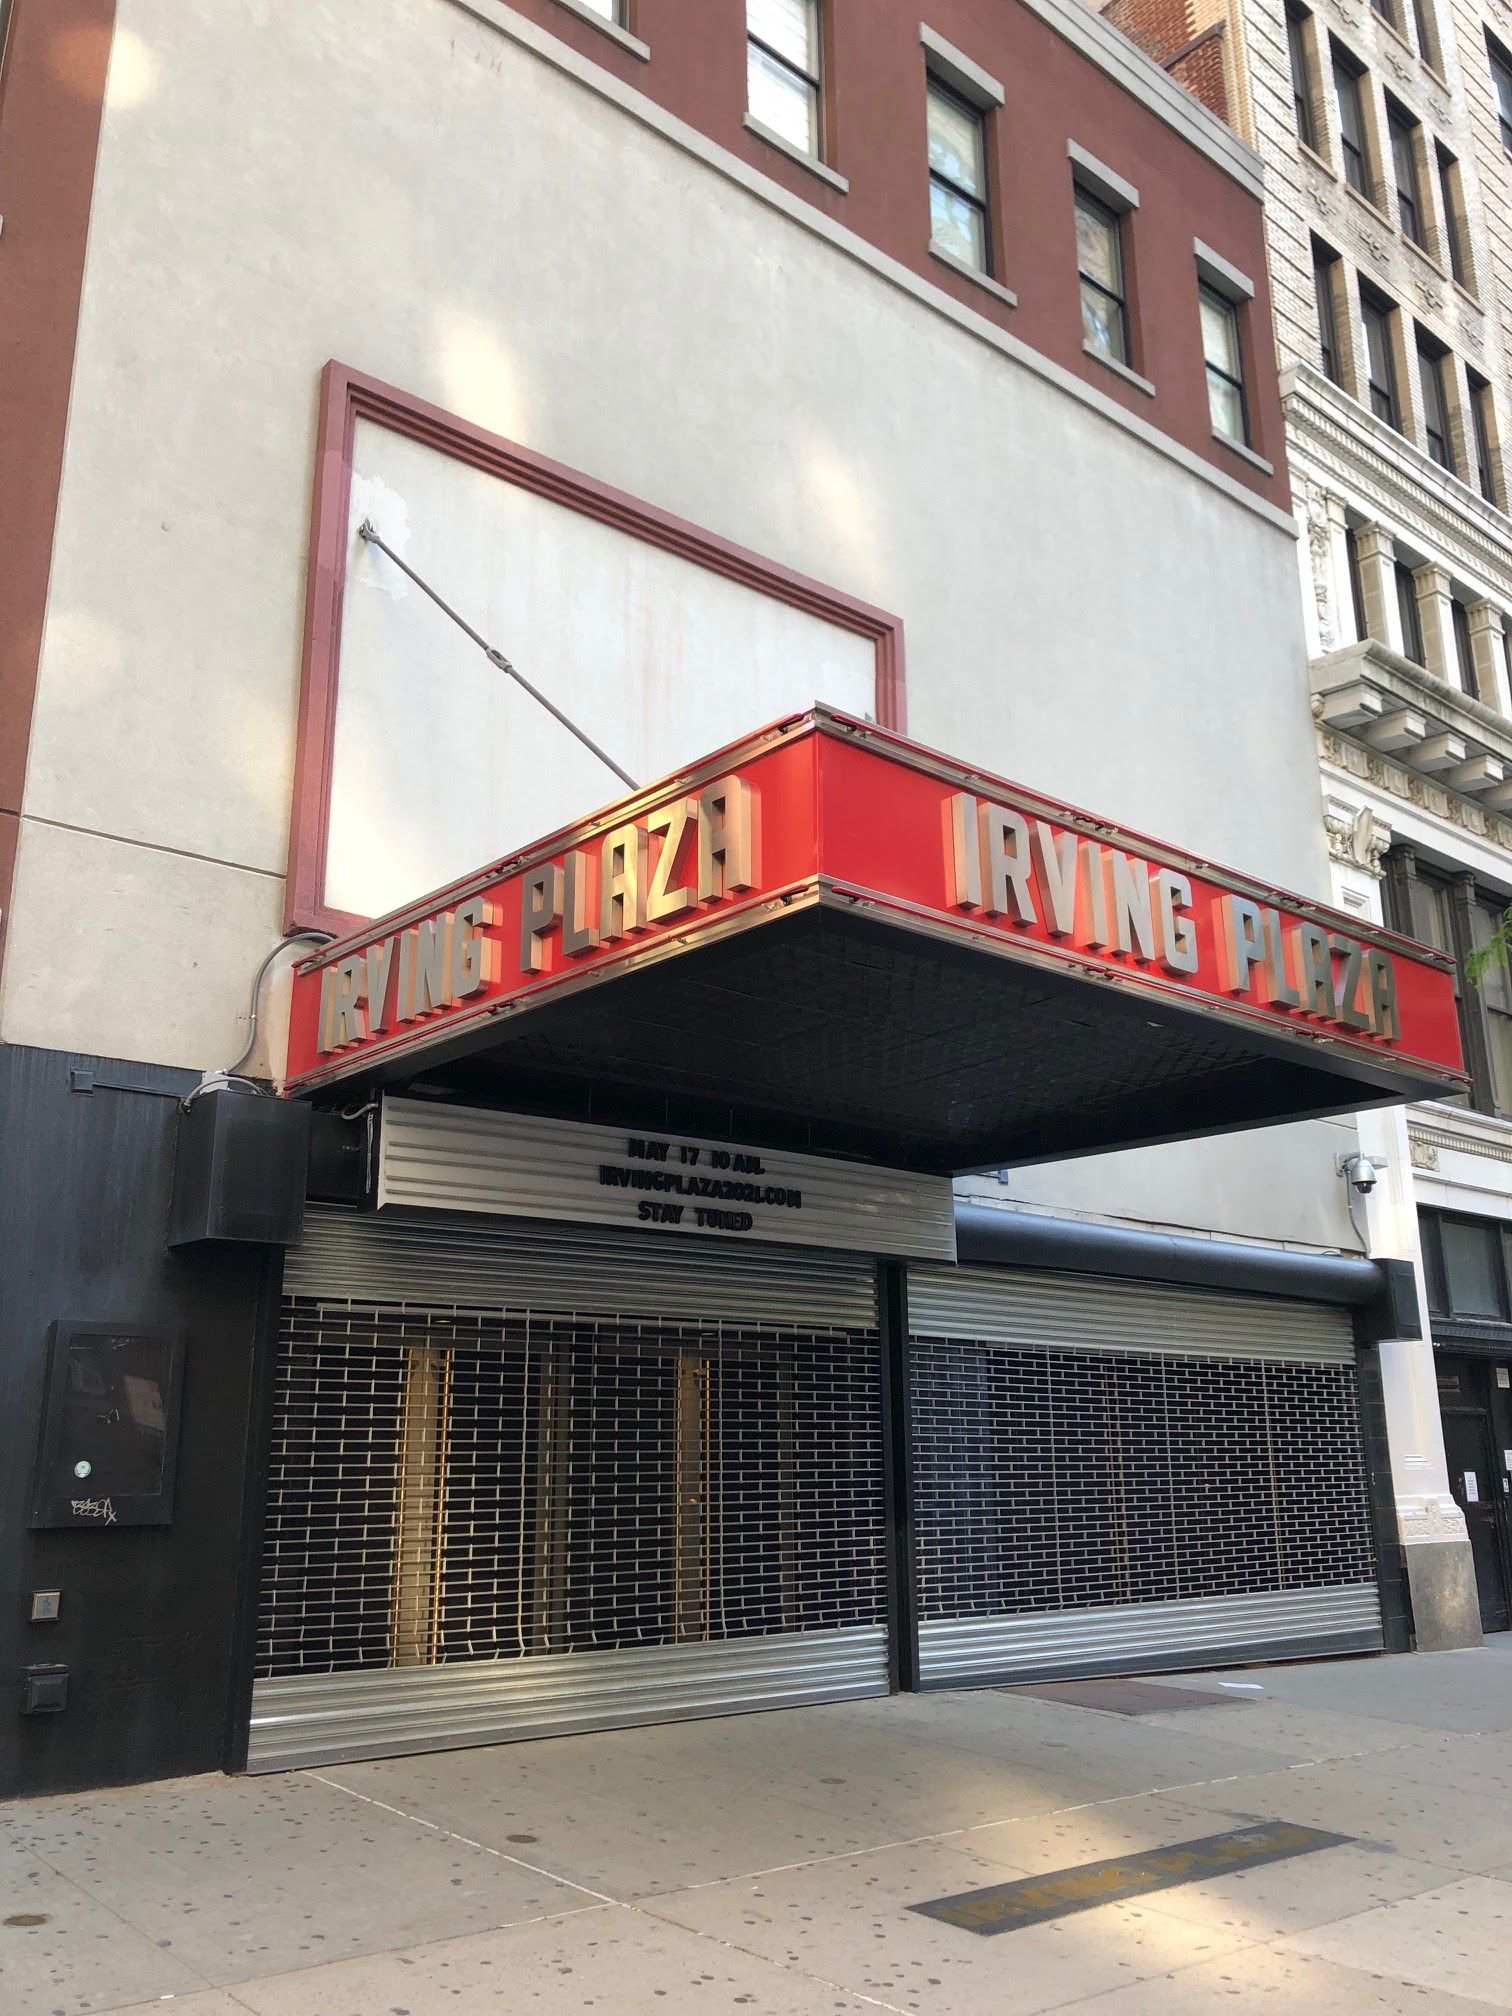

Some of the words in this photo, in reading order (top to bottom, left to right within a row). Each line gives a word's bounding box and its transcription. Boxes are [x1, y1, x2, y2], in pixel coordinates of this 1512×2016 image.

[318, 896, 502, 1054] IRVING
[521, 775, 754, 974] PLAZA
[950, 792, 1199, 976] IRVING
[1220, 894, 1401, 1043] PLAZA
[629, 1138, 671, 1161] MAY
[680, 1146, 700, 1166] 17
[711, 1150, 731, 1169] 10
[599, 1165, 802, 1209] IRVINGPLAZA2021.COM
[638, 1201, 684, 1224] STAY
[694, 1207, 753, 1231] TUNED
